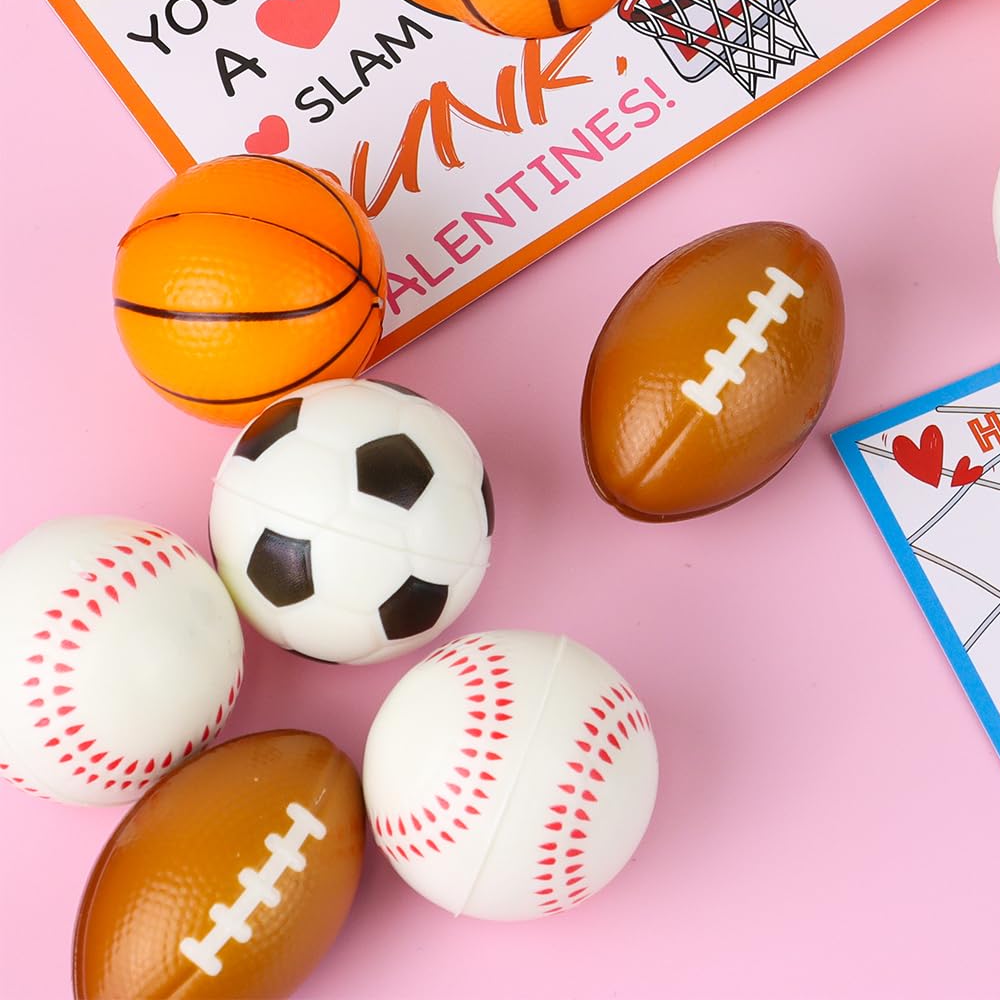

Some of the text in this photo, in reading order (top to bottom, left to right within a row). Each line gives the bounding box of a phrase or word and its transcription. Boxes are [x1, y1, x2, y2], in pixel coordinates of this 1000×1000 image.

[215, 48, 267, 97] A
[295, 15, 433, 124] SLAM
[386, 76, 676, 315] ALENTINES!
